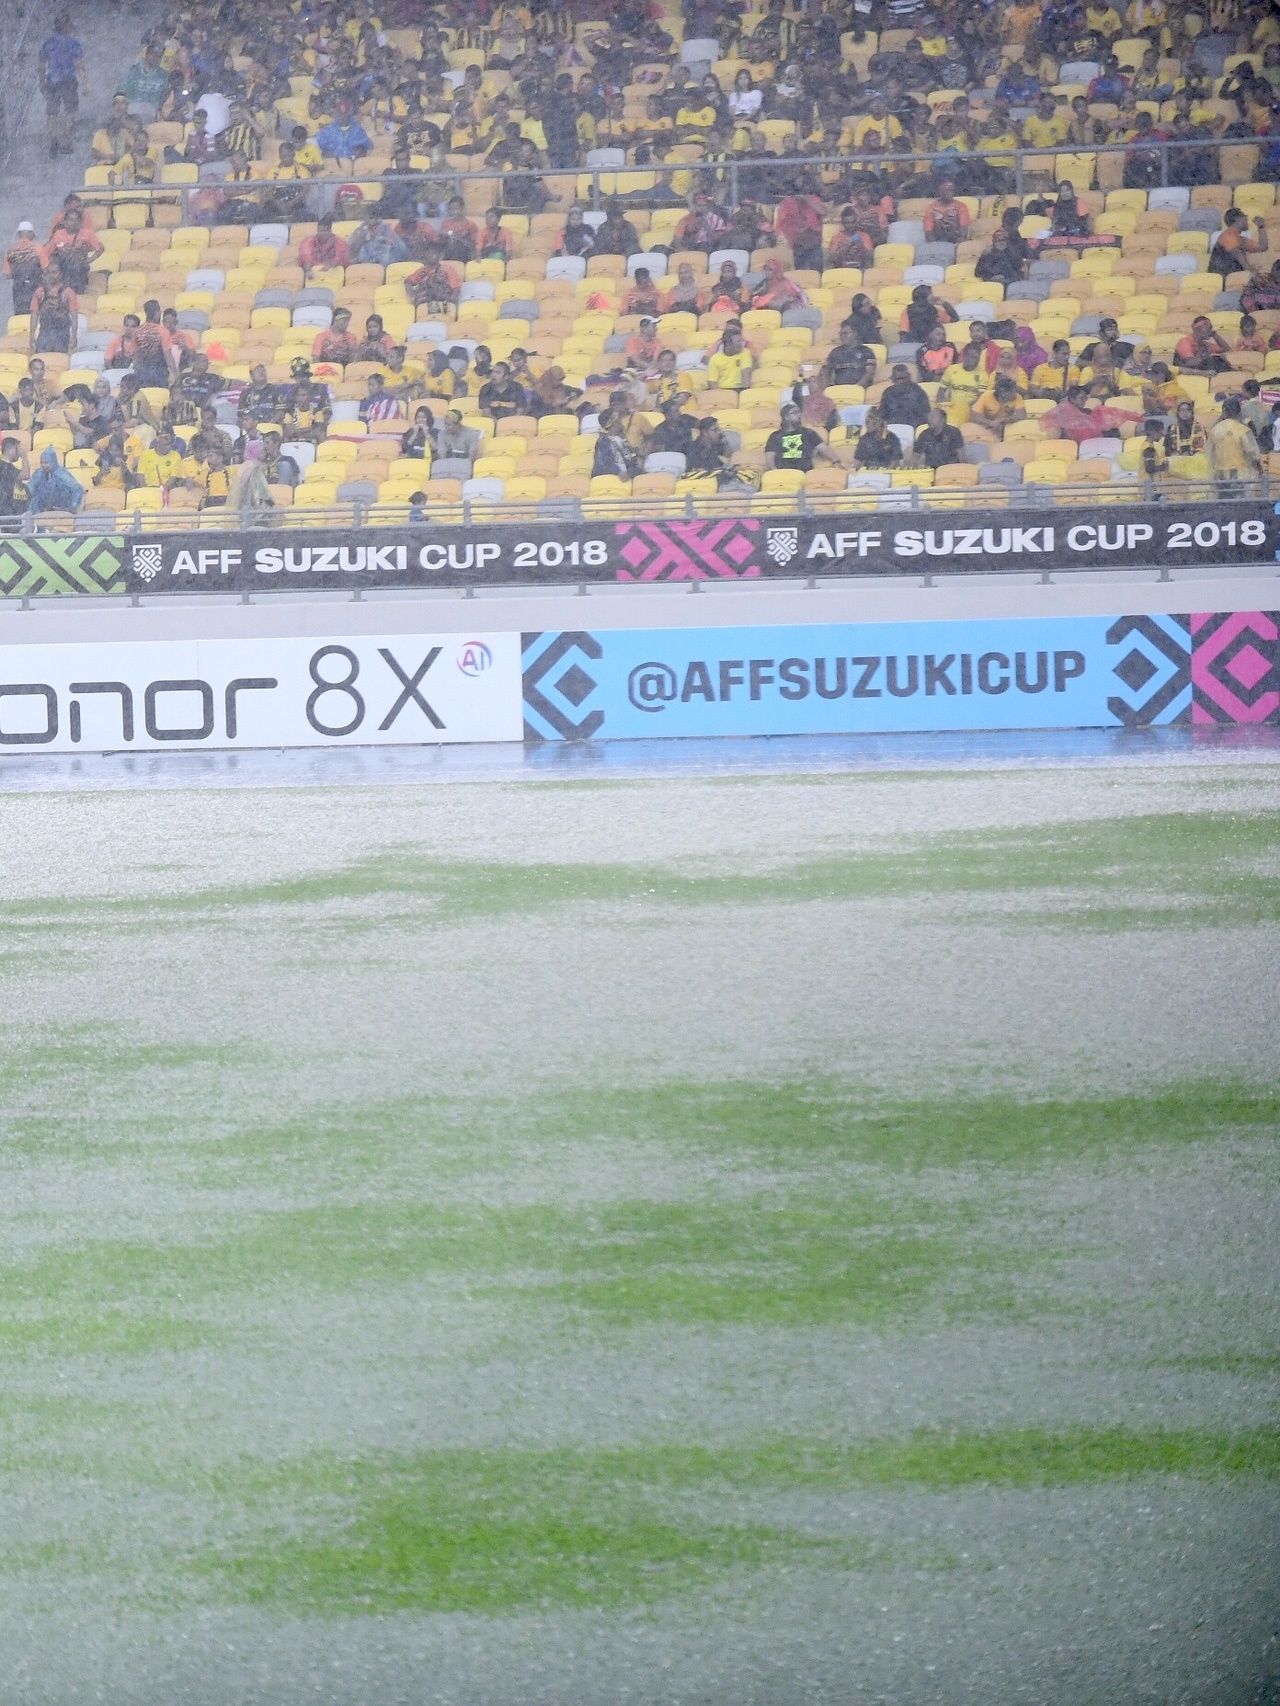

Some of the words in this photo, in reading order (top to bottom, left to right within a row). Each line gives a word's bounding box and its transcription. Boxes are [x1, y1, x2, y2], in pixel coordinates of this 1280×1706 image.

[171, 549, 243, 575] AFF
[254, 545, 408, 574] SUZUKI
[418, 542, 502, 570] CUP
[513, 540, 609, 567] 2018
[805, 530, 882, 559] AFF
[893, 526, 1055, 557] SUZUKI
[1066, 523, 1154, 552] CUP
[1166, 520, 1266, 548] 2018
[305, 644, 447, 737] 8X
[628, 650, 1086, 713] @AFFSUZUKICUP
